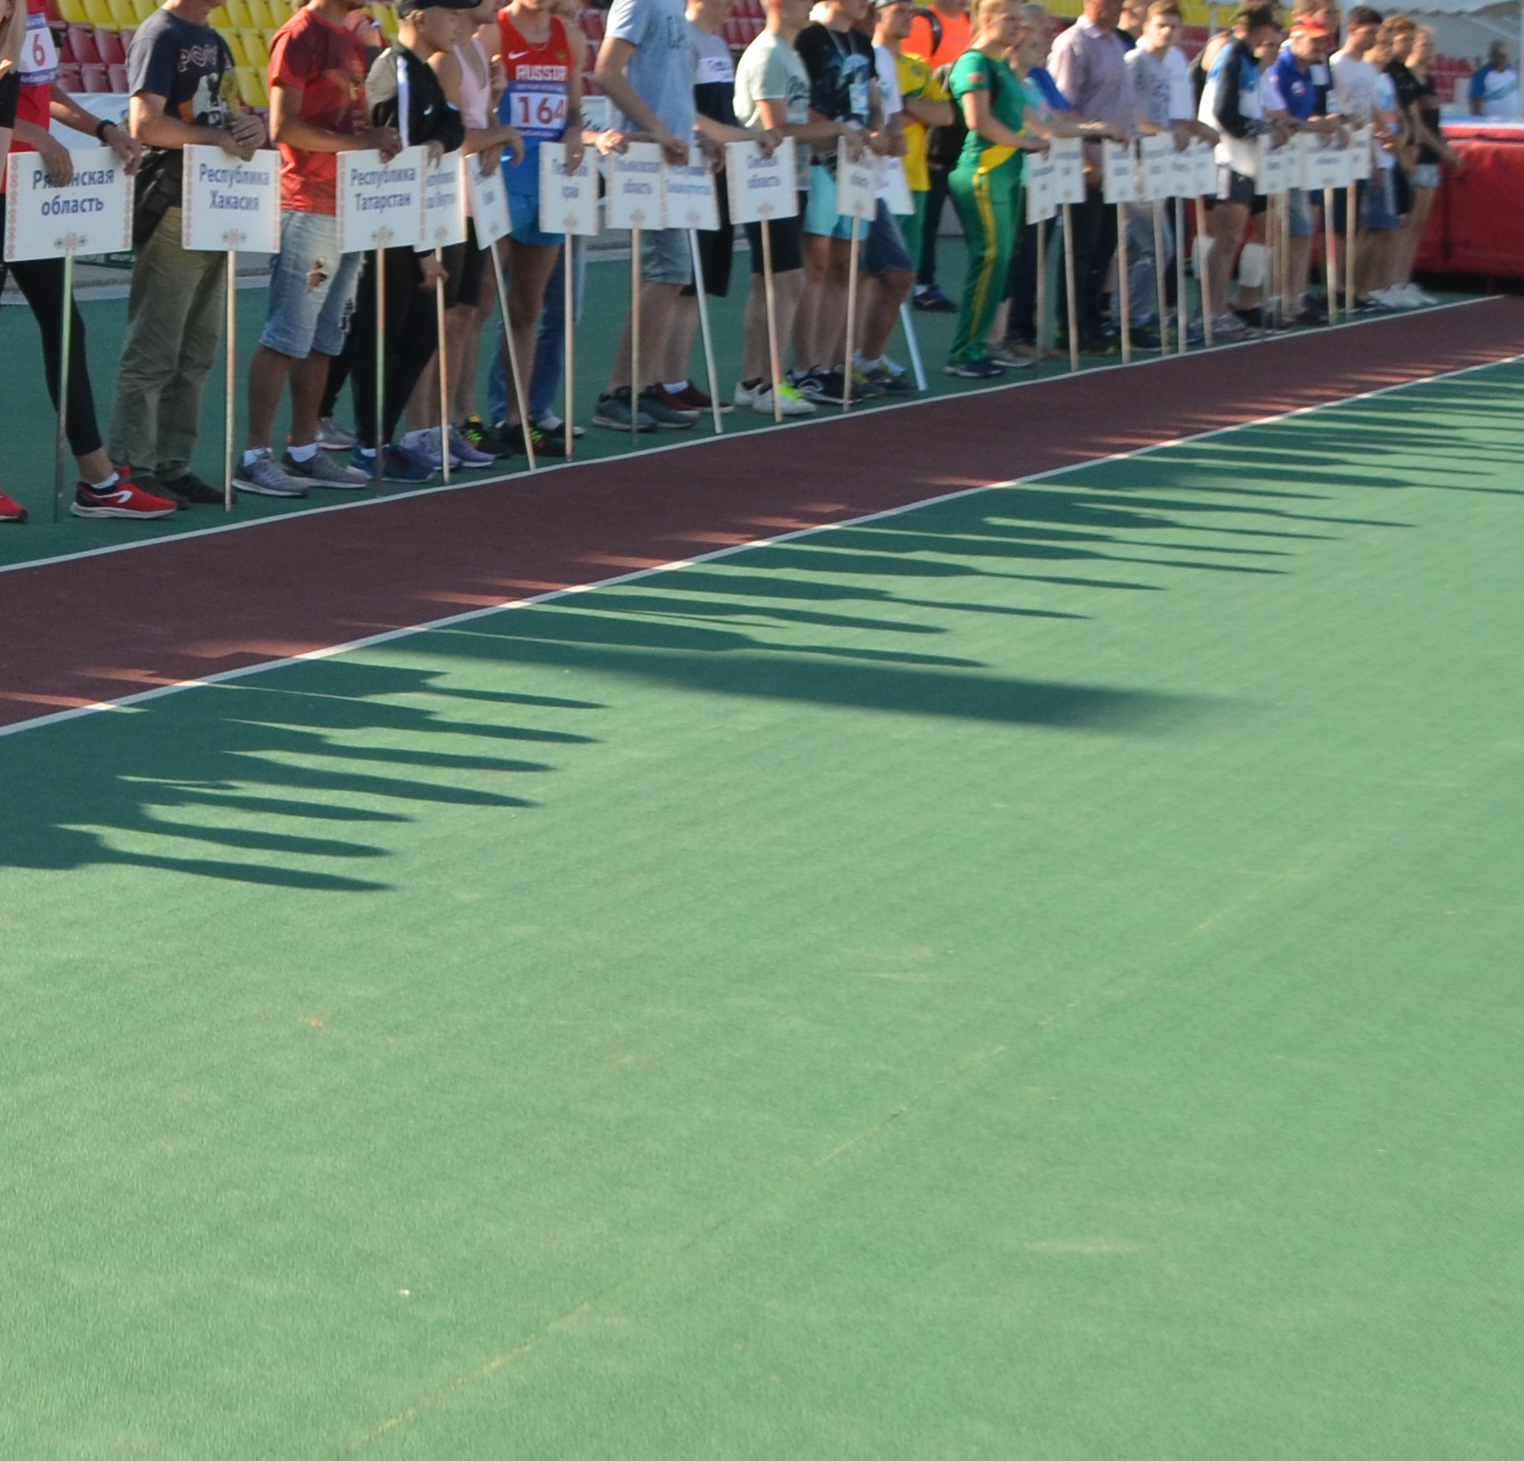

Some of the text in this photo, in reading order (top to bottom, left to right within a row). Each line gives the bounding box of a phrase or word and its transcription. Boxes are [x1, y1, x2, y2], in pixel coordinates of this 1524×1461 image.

[32, 33, 46, 68] 6
[515, 64, 569, 82] RUSSIA
[517, 95, 567, 126] 164
[32, 168, 115, 190] Рянская
[198, 163, 270, 189] Республика
[350, 165, 416, 189] Республика
[40, 194, 105, 217] область
[209, 190, 260, 211] Хакасия
[354, 192, 412, 214] Татарстан
